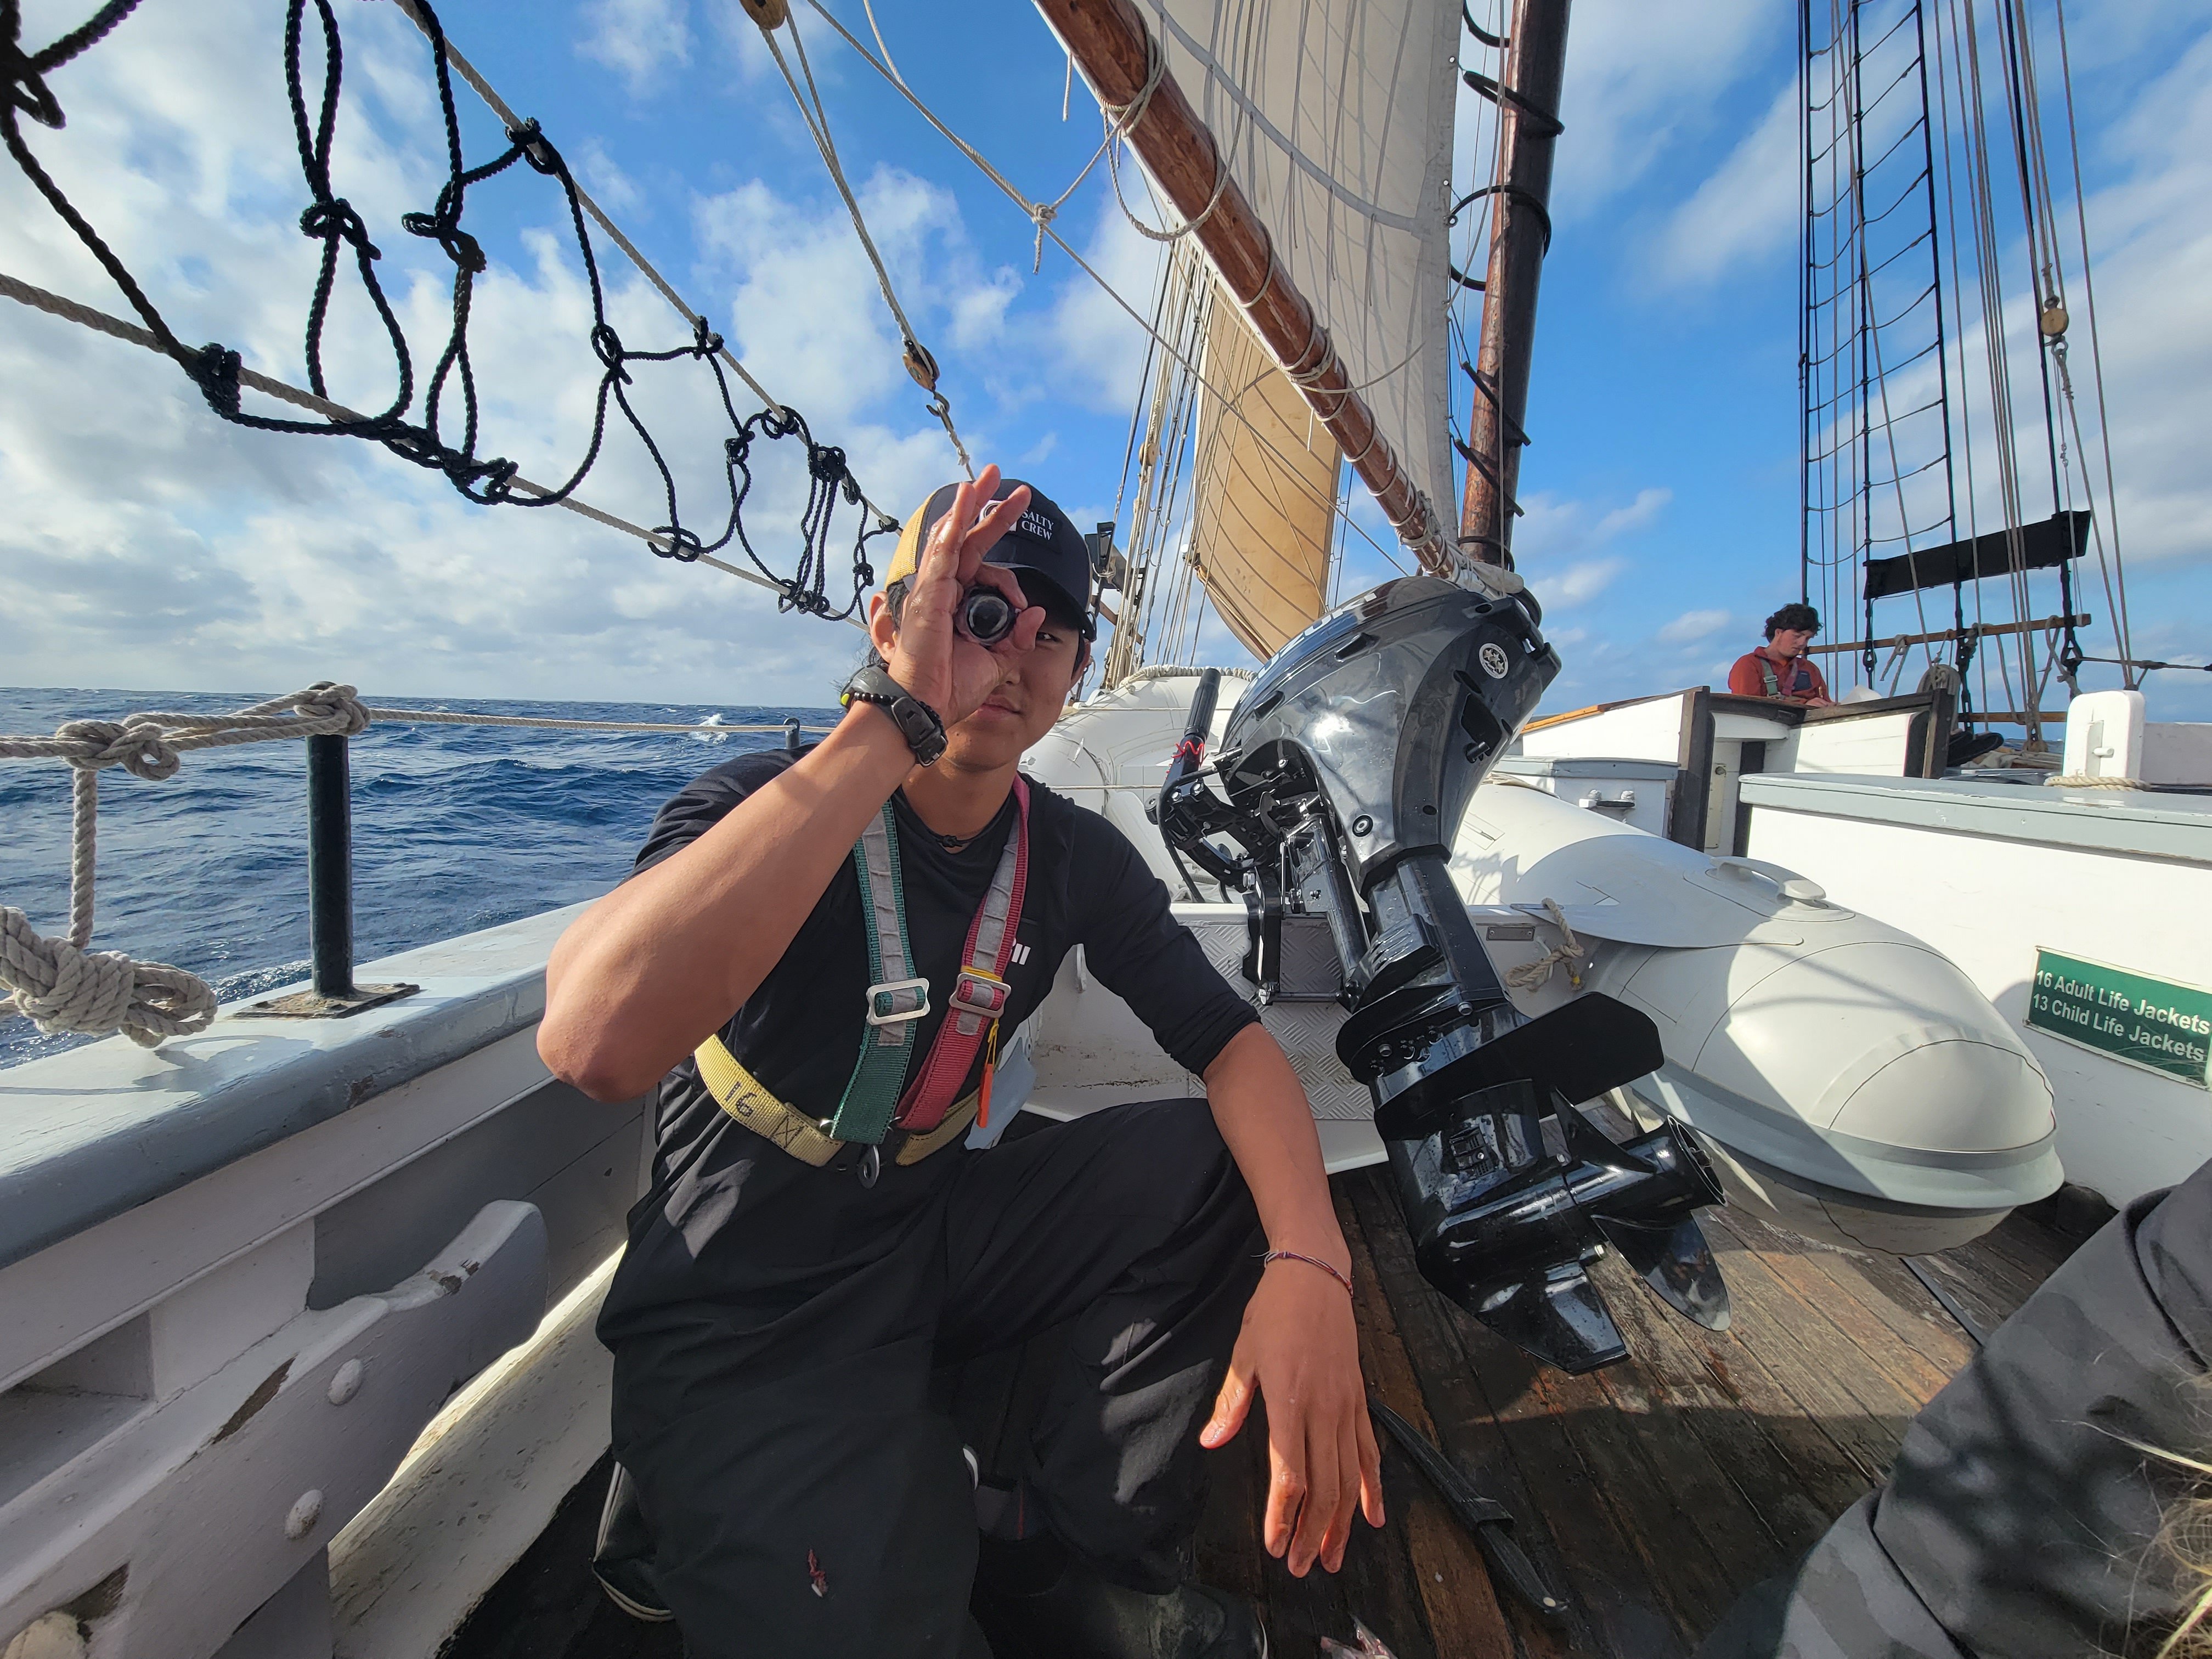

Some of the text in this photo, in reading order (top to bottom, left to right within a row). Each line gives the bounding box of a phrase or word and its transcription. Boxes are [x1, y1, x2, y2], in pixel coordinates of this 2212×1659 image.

[1022, 509, 1054, 531] SALTY
[1022, 520, 1053, 540] CREW
[2036, 970, 2211, 1035] 16 Adult Life Jackets
[2033, 993, 2205, 1062] 13 Child Life Jackets
